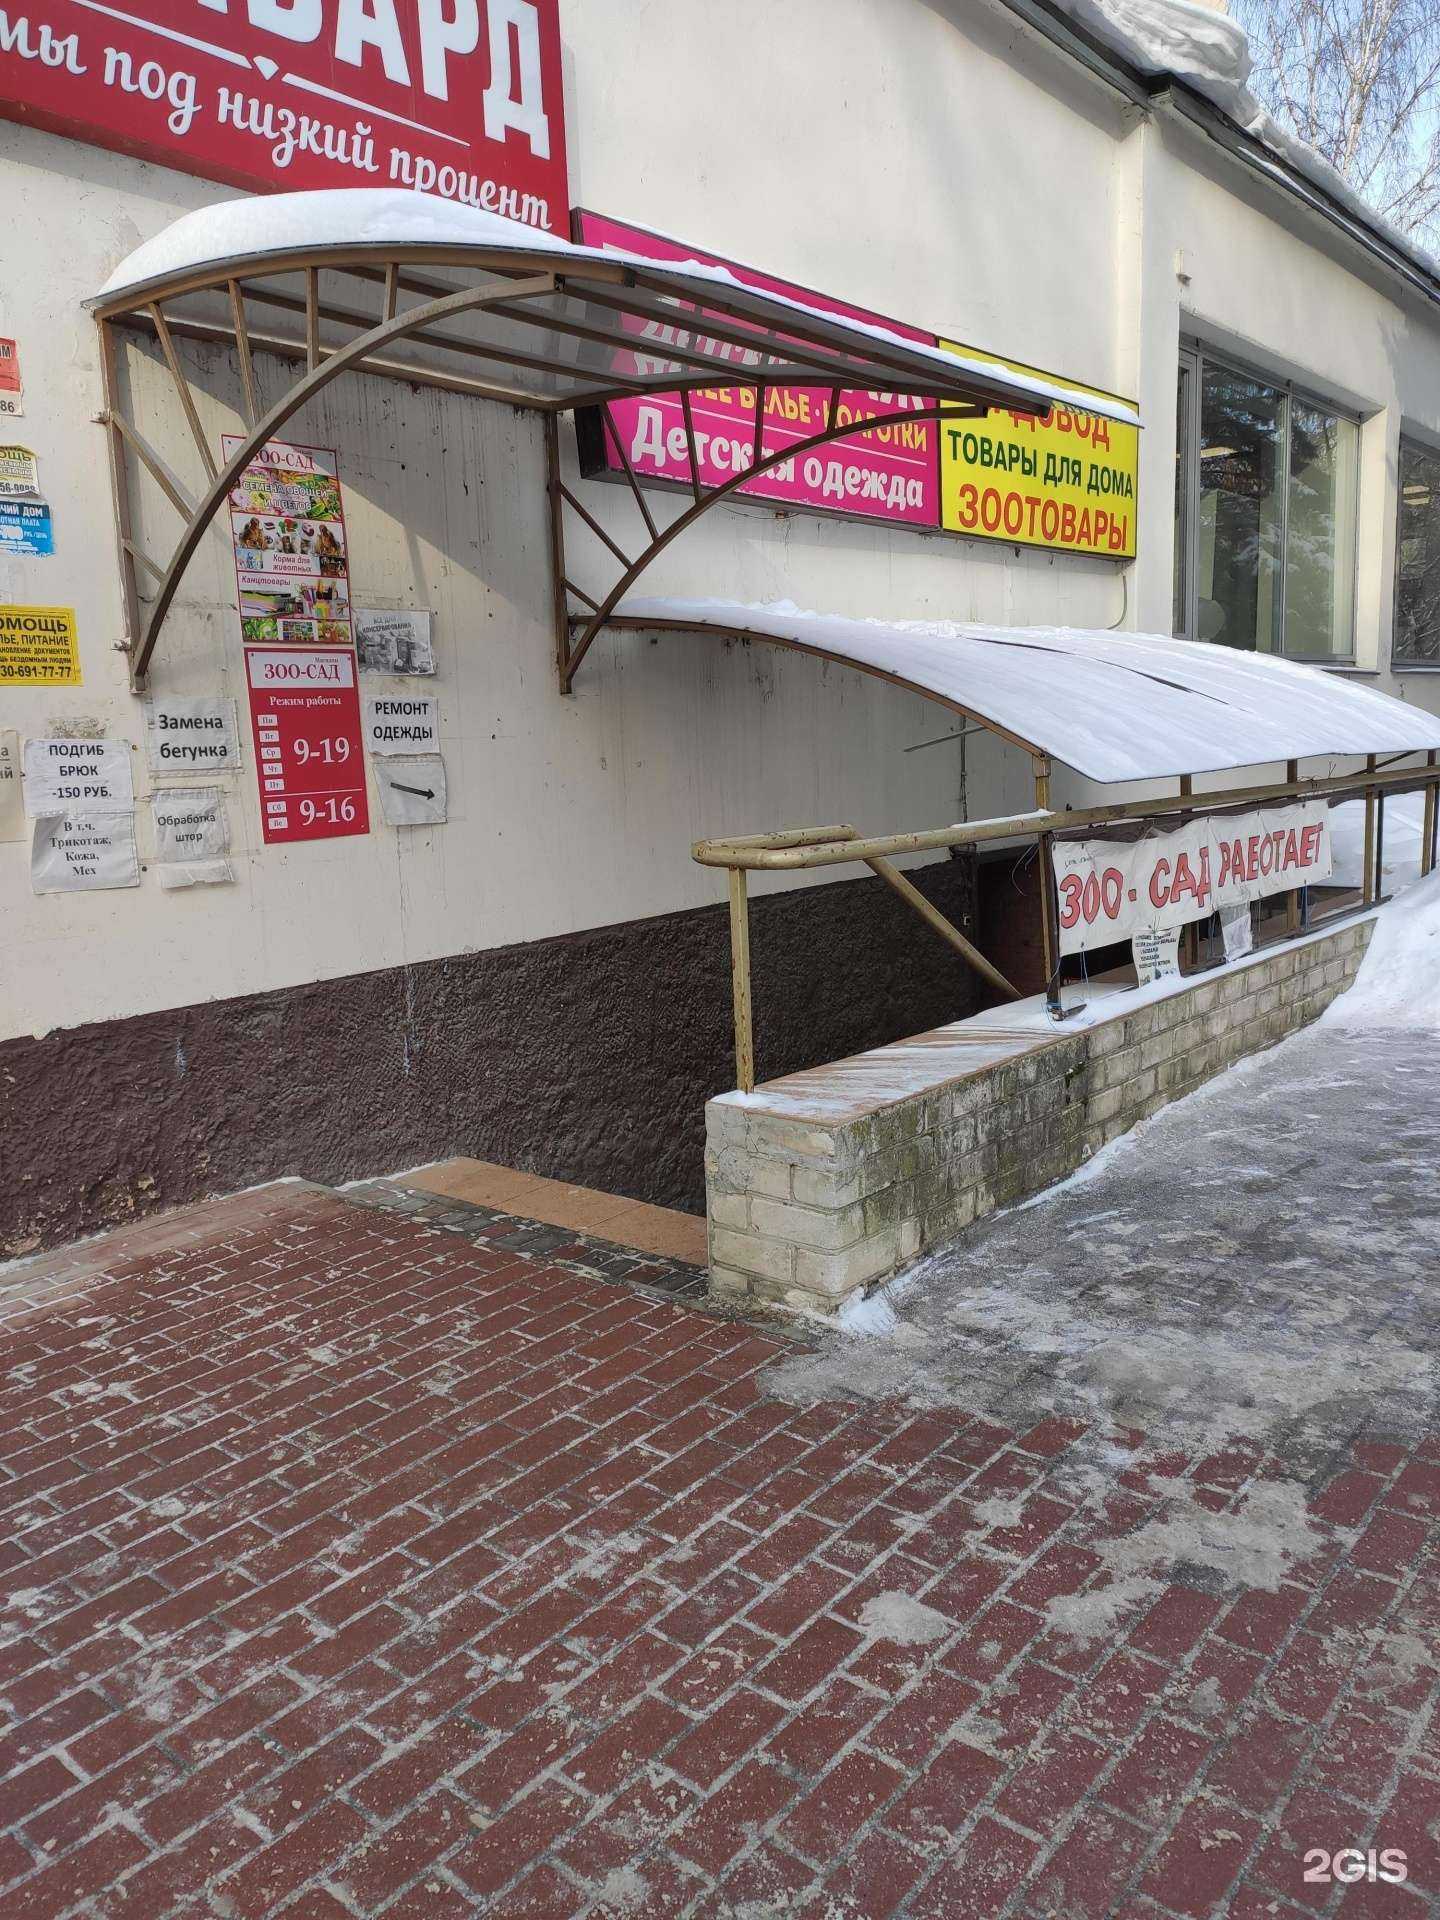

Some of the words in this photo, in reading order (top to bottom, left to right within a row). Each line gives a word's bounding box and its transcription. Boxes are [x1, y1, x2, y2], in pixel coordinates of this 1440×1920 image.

[104, 47, 202, 135] под
[217, 87, 379, 168] низкий
[389, 147, 552, 229] процент
[948, 429, 1037, 477] ТОВАРЫ
[1043, 452, 1082, 487] ДЛЯ
[1087, 463, 1134, 500] ДОМА
[803, 457, 924, 511] одежда
[23, 506, 44, 518] ДОМ
[958, 483, 1127, 551] ЗООТОВАРЫ
[272, 564, 312, 573] животных
[241, 575, 291, 586] Канцтовары
[22, 635, 70, 646] ПИТАНИЕ
[264, 663, 341, 682] ЗОО-САД
[269, 696, 304, 706] Режим
[307, 696, 342, 708] работы
[375, 702, 429, 715] РЕМОНТ
[158, 714, 224, 730] Замена
[373, 726, 432, 741] ОДЕЖДЫ
[49, 744, 104, 759] ПОДГИБ
[160, 742, 228, 761] бегунка
[293, 737, 350, 765] 9-19
[59, 765, 98, 777] БРЮК
[52, 787, 81, 799] -150
[84, 786, 112, 799] РУБ.
[299, 797, 355, 826] 9-16
[64, 821, 73, 832] В
[157, 814, 216, 827] Обработка
[175, 832, 203, 843] штор
[65, 851, 100, 862] Кожа,
[73, 866, 97, 876] Мех
[1149, 845, 1211, 908] САД
